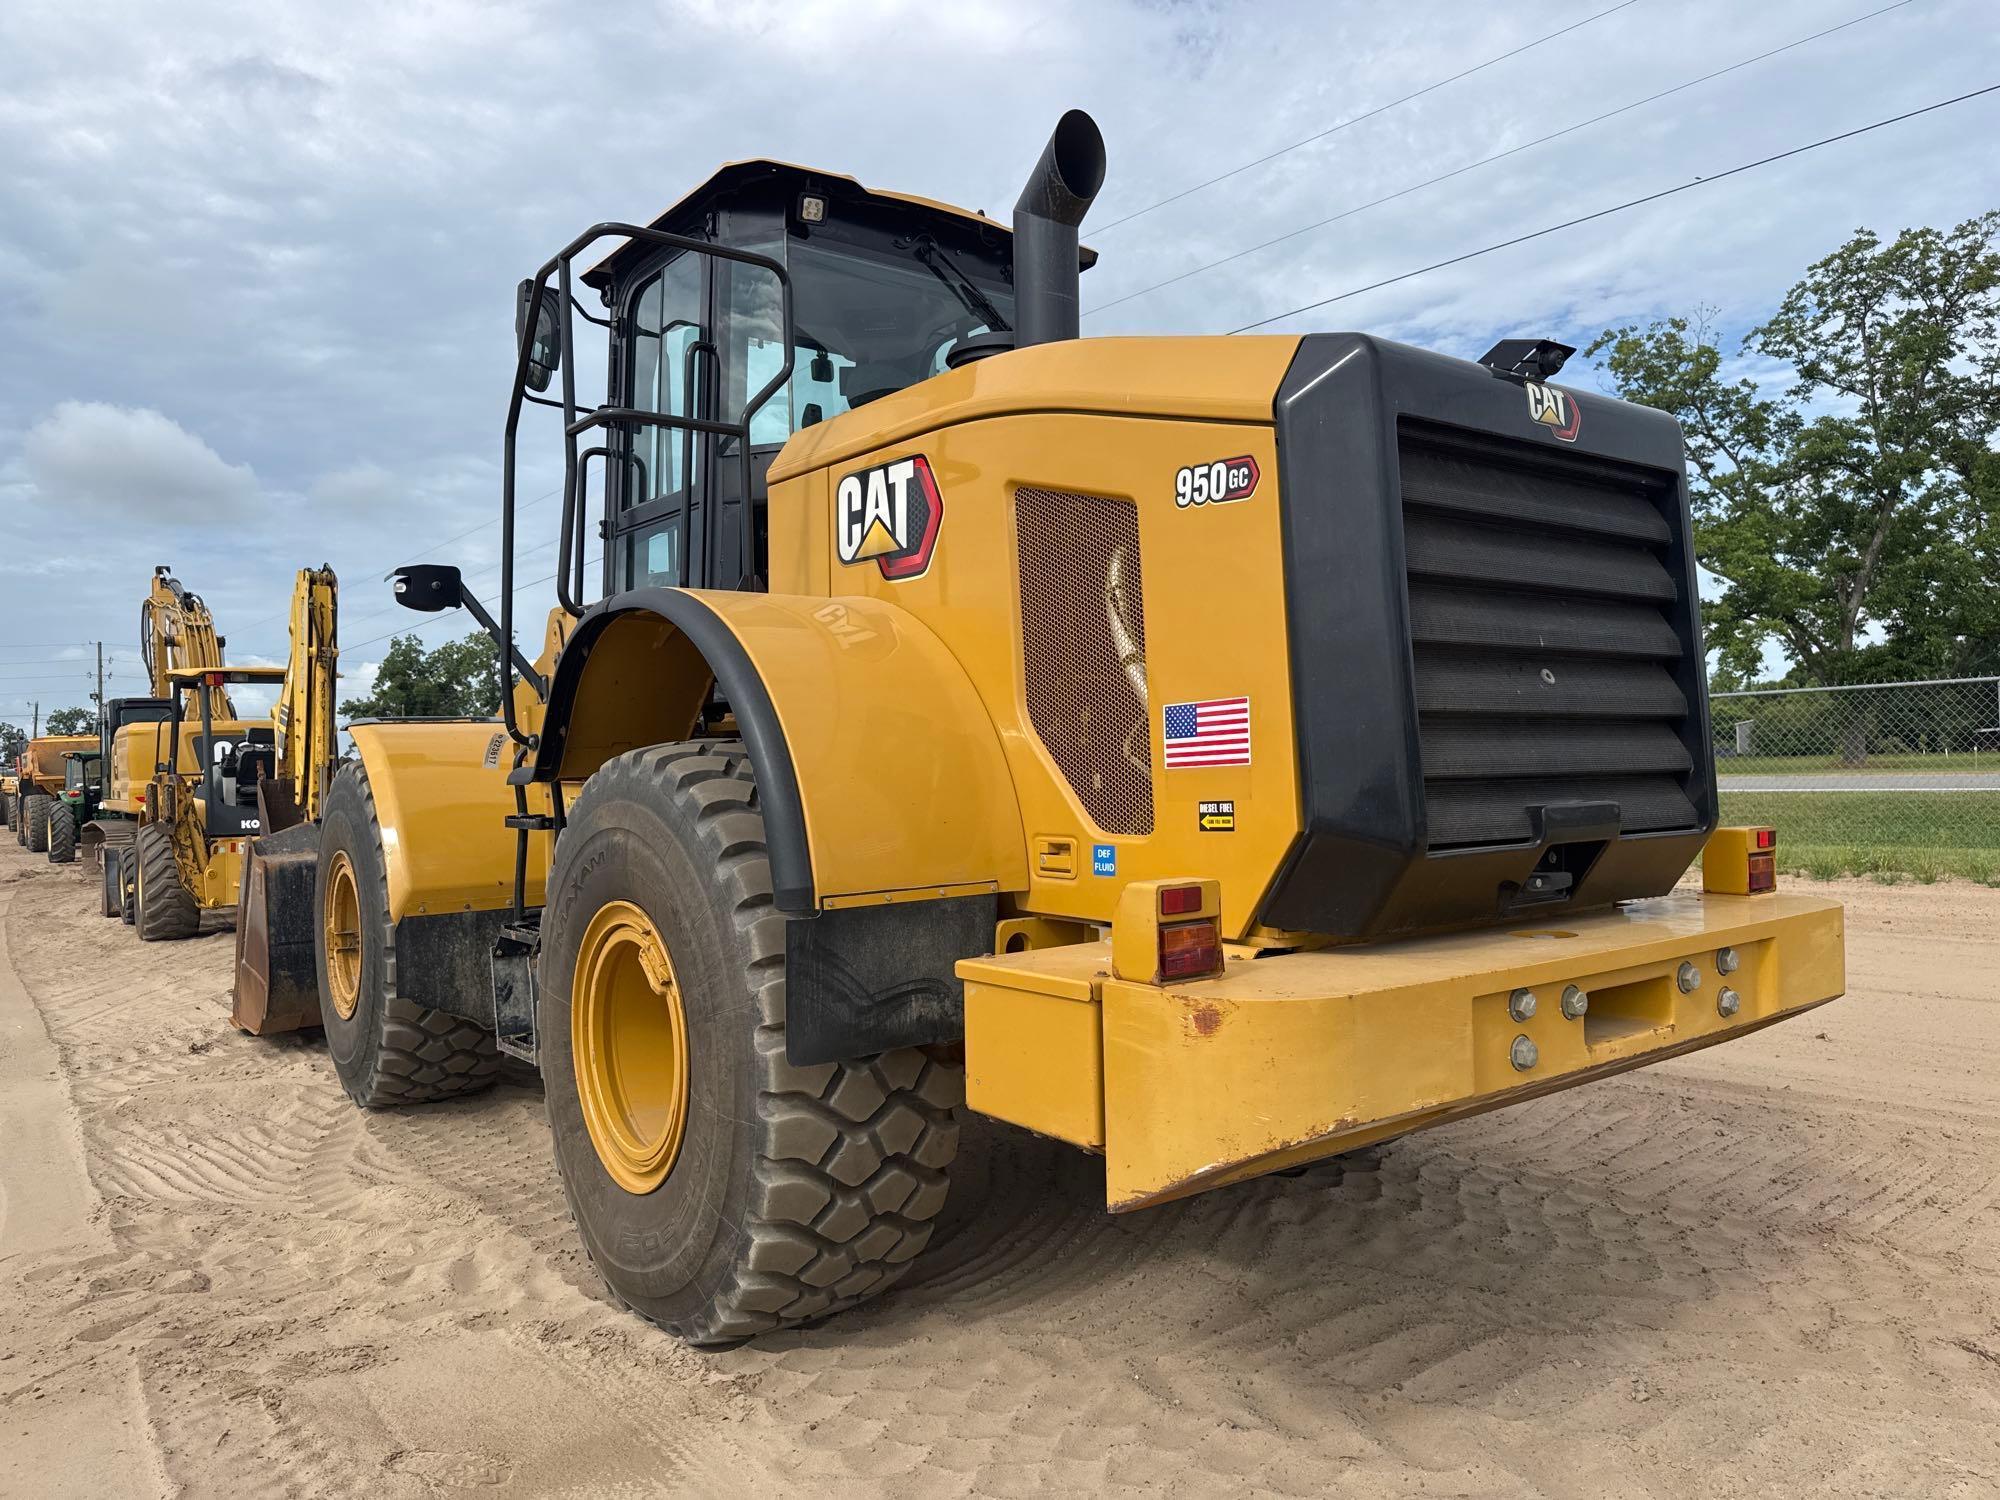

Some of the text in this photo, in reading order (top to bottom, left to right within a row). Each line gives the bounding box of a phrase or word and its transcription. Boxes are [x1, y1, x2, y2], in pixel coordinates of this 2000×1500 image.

[1526, 382, 1565, 427] CAT
[1177, 462, 1249, 506] 950 GC
[838, 459, 914, 561] CAT
[1200, 803, 1233, 813] DIESEL FUEL
[1095, 862, 1115, 872] FLUID
[1097, 849, 1111, 858] DEF
